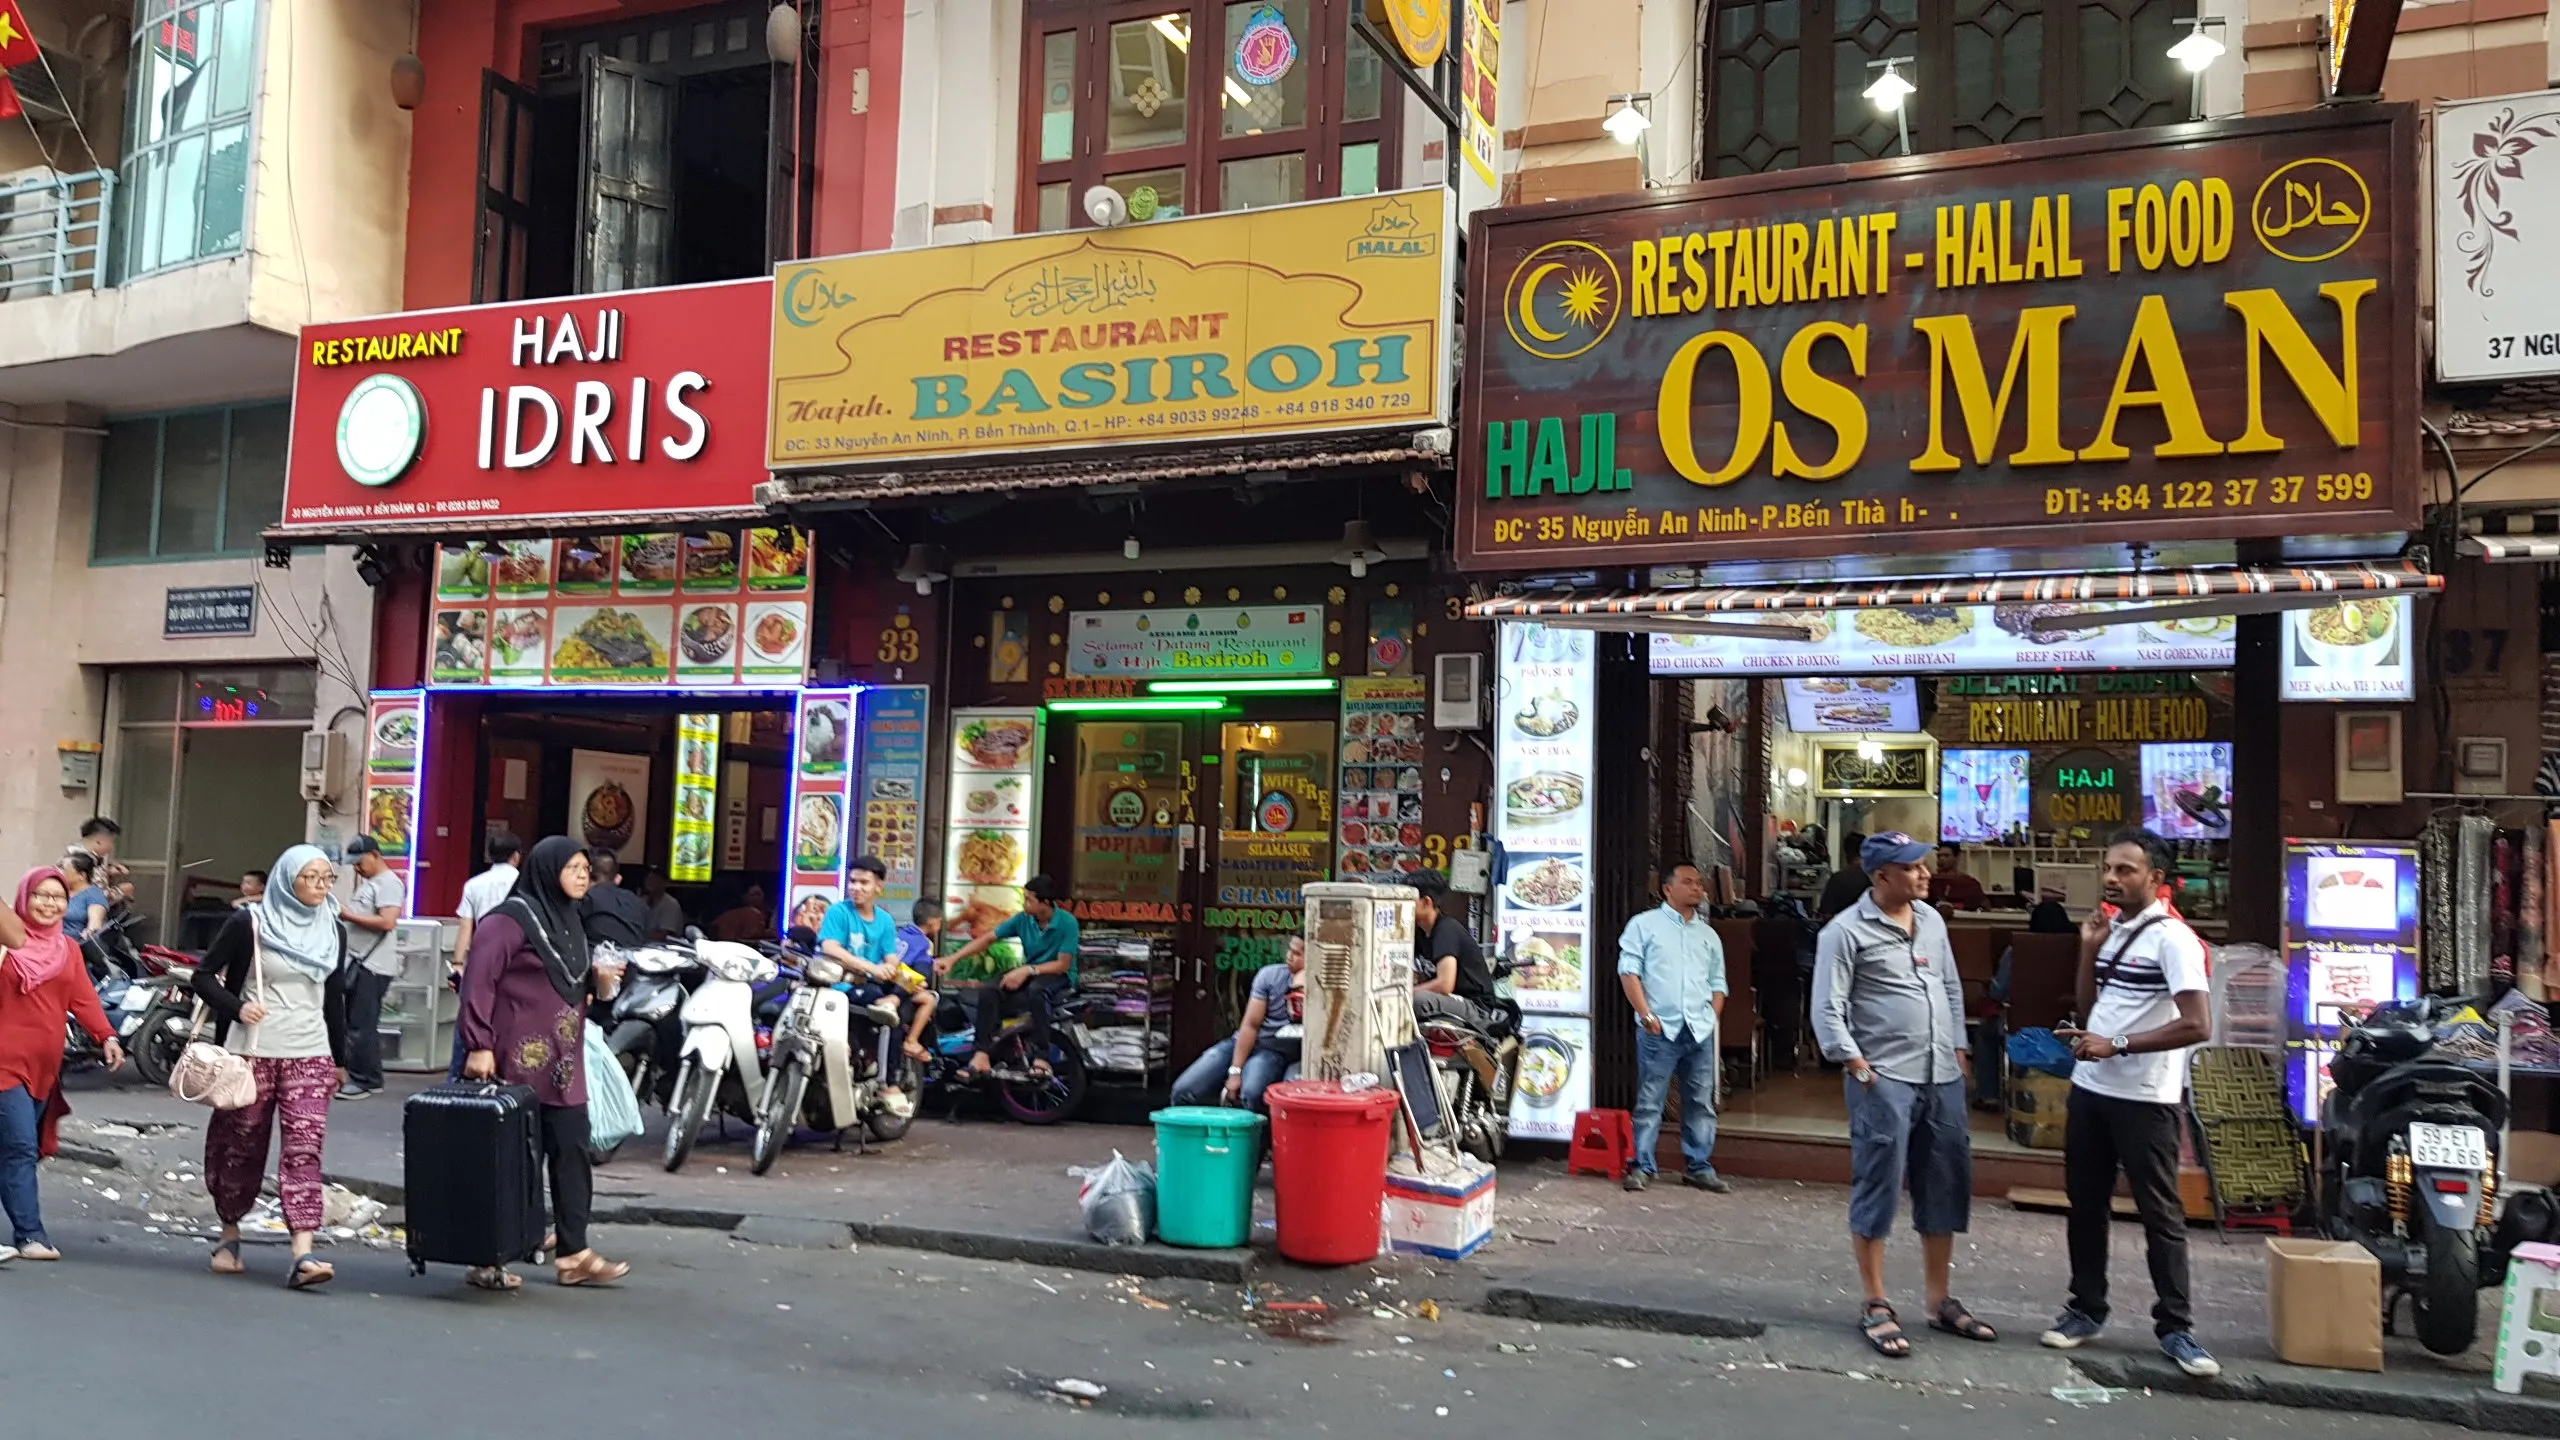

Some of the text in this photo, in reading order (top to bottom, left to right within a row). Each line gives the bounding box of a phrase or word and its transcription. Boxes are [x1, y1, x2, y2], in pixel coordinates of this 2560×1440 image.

[2262, 179, 2361, 238] حلال
[1357, 241, 1425, 255] HALAL
[1631, 212, 1897, 318] RESTAURANT
[1936, 194, 2083, 289] HALAL
[2108, 176, 2235, 274] FOOD
[312, 327, 463, 366] RESTAURANT
[512, 308, 622, 366] HAJI
[943, 311, 1229, 362] RESTAURANT
[2488, 336, 2516, 359] 37
[910, 334, 1411, 420] BASIROH
[1657, 278, 2378, 488] OS MAN
[478, 370, 709, 469] IDRIS
[785, 439, 811, 451] ĐC:
[815, 438, 831, 449] 33
[835, 432, 888, 451] Nguyễn
[892, 432, 912, 444] An
[916, 429, 953, 444] Ninh,
[959, 428, 970, 440] P.
[975, 426, 1004, 439] Bến
[1010, 421, 1060, 437] Thành,
[1104, 415, 1132, 430] HP:
[1138, 413, 1165, 427] +84
[1170, 410, 1207, 425] 9033
[1212, 405, 1260, 422] 99248
[1276, 401, 1305, 416] +84
[1311, 399, 1339, 413] 918
[1345, 396, 1374, 410] 340
[1381, 393, 1411, 407] 729
[786, 395, 893, 425] Hajah.
[1486, 412, 1633, 499] HAJI.
[1536, 516, 1565, 541] 35
[1572, 506, 1650, 543] Nguyễn
[1659, 510, 1688, 535] An
[2046, 488, 2090, 516] ĐT:
[2097, 484, 2152, 513] +84
[2161, 481, 2214, 510] 122
[2225, 478, 2257, 507] 37
[2270, 475, 2303, 504] 37
[2316, 472, 2374, 502] 599
[878, 628, 919, 662] 33
[1172, 650, 1269, 669] Basiroh
[1742, 654, 1841, 668] CHICKEN BOXING
[1872, 652, 1956, 666] NASI BIRYANI
[2016, 649, 2097, 663] BEEF STEAK
[2137, 648, 2162, 660] NASI
[2164, 647, 2208, 660] GORENG
[1649, 656, 1724, 669] IED CHICKEN
[2288, 680, 2311, 692] MEE
[1969, 700, 2081, 742] RESTAURANT
[2096, 698, 2154, 742] HALAL
[2160, 697, 2209, 740] FOOD
[2058, 767, 2115, 789] HAJI
[2078, 793, 2123, 822] MAN
